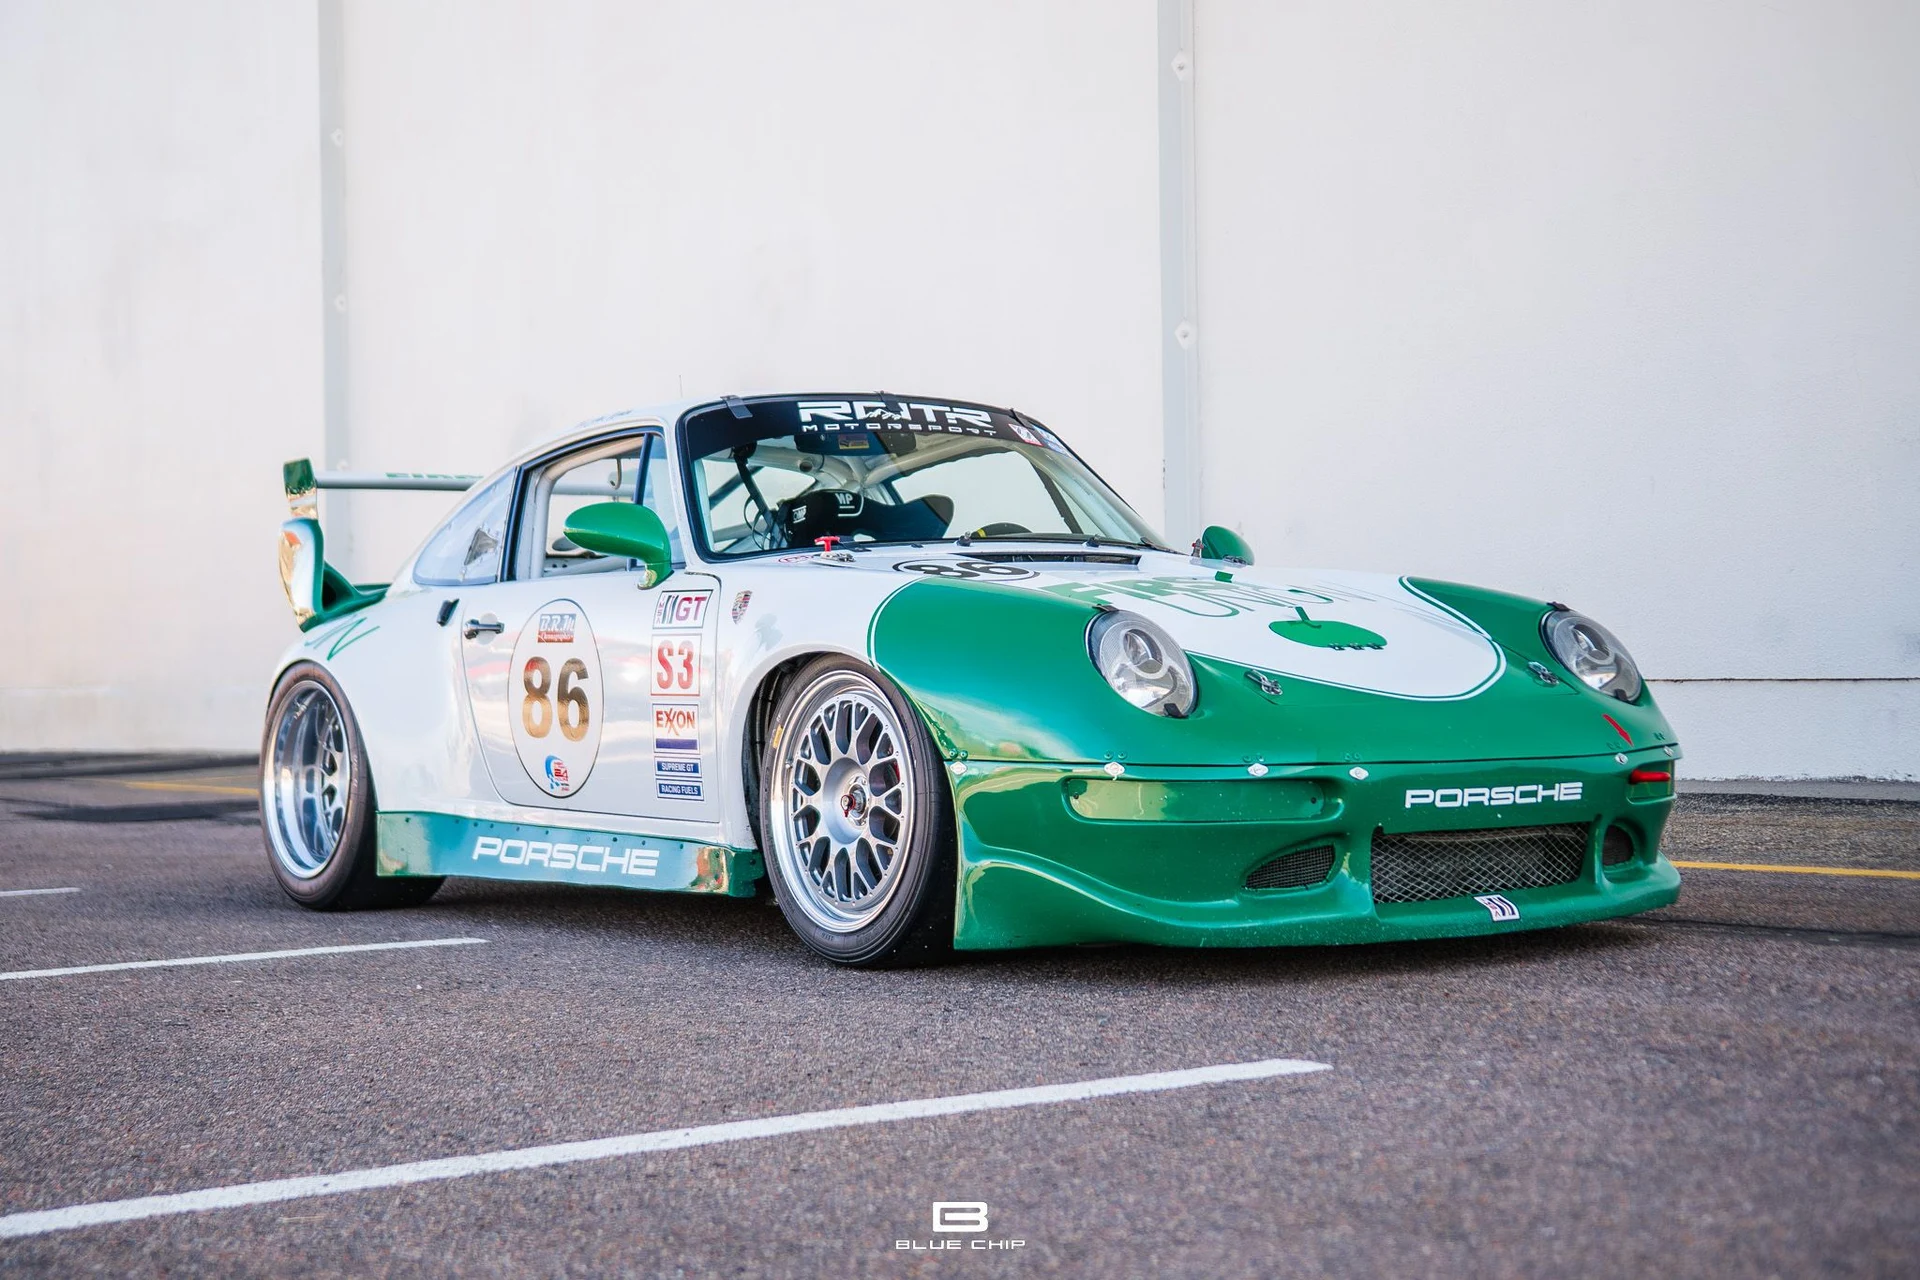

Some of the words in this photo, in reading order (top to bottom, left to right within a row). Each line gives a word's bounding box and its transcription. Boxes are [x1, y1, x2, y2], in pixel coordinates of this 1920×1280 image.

[802, 422, 997, 436] MOTORSPORT
[903, 561, 1030, 578] 86
[675, 596, 708, 621] GT
[656, 639, 695, 690] S3
[522, 656, 590, 742] 86
[655, 707, 696, 736] EXXON
[661, 762, 687, 772] SUPREME
[661, 784, 681, 794] RACING
[681, 786, 698, 795] FUELS
[1404, 781, 1583, 809] PORSCHE
[472, 835, 660, 877] PORSCHE
